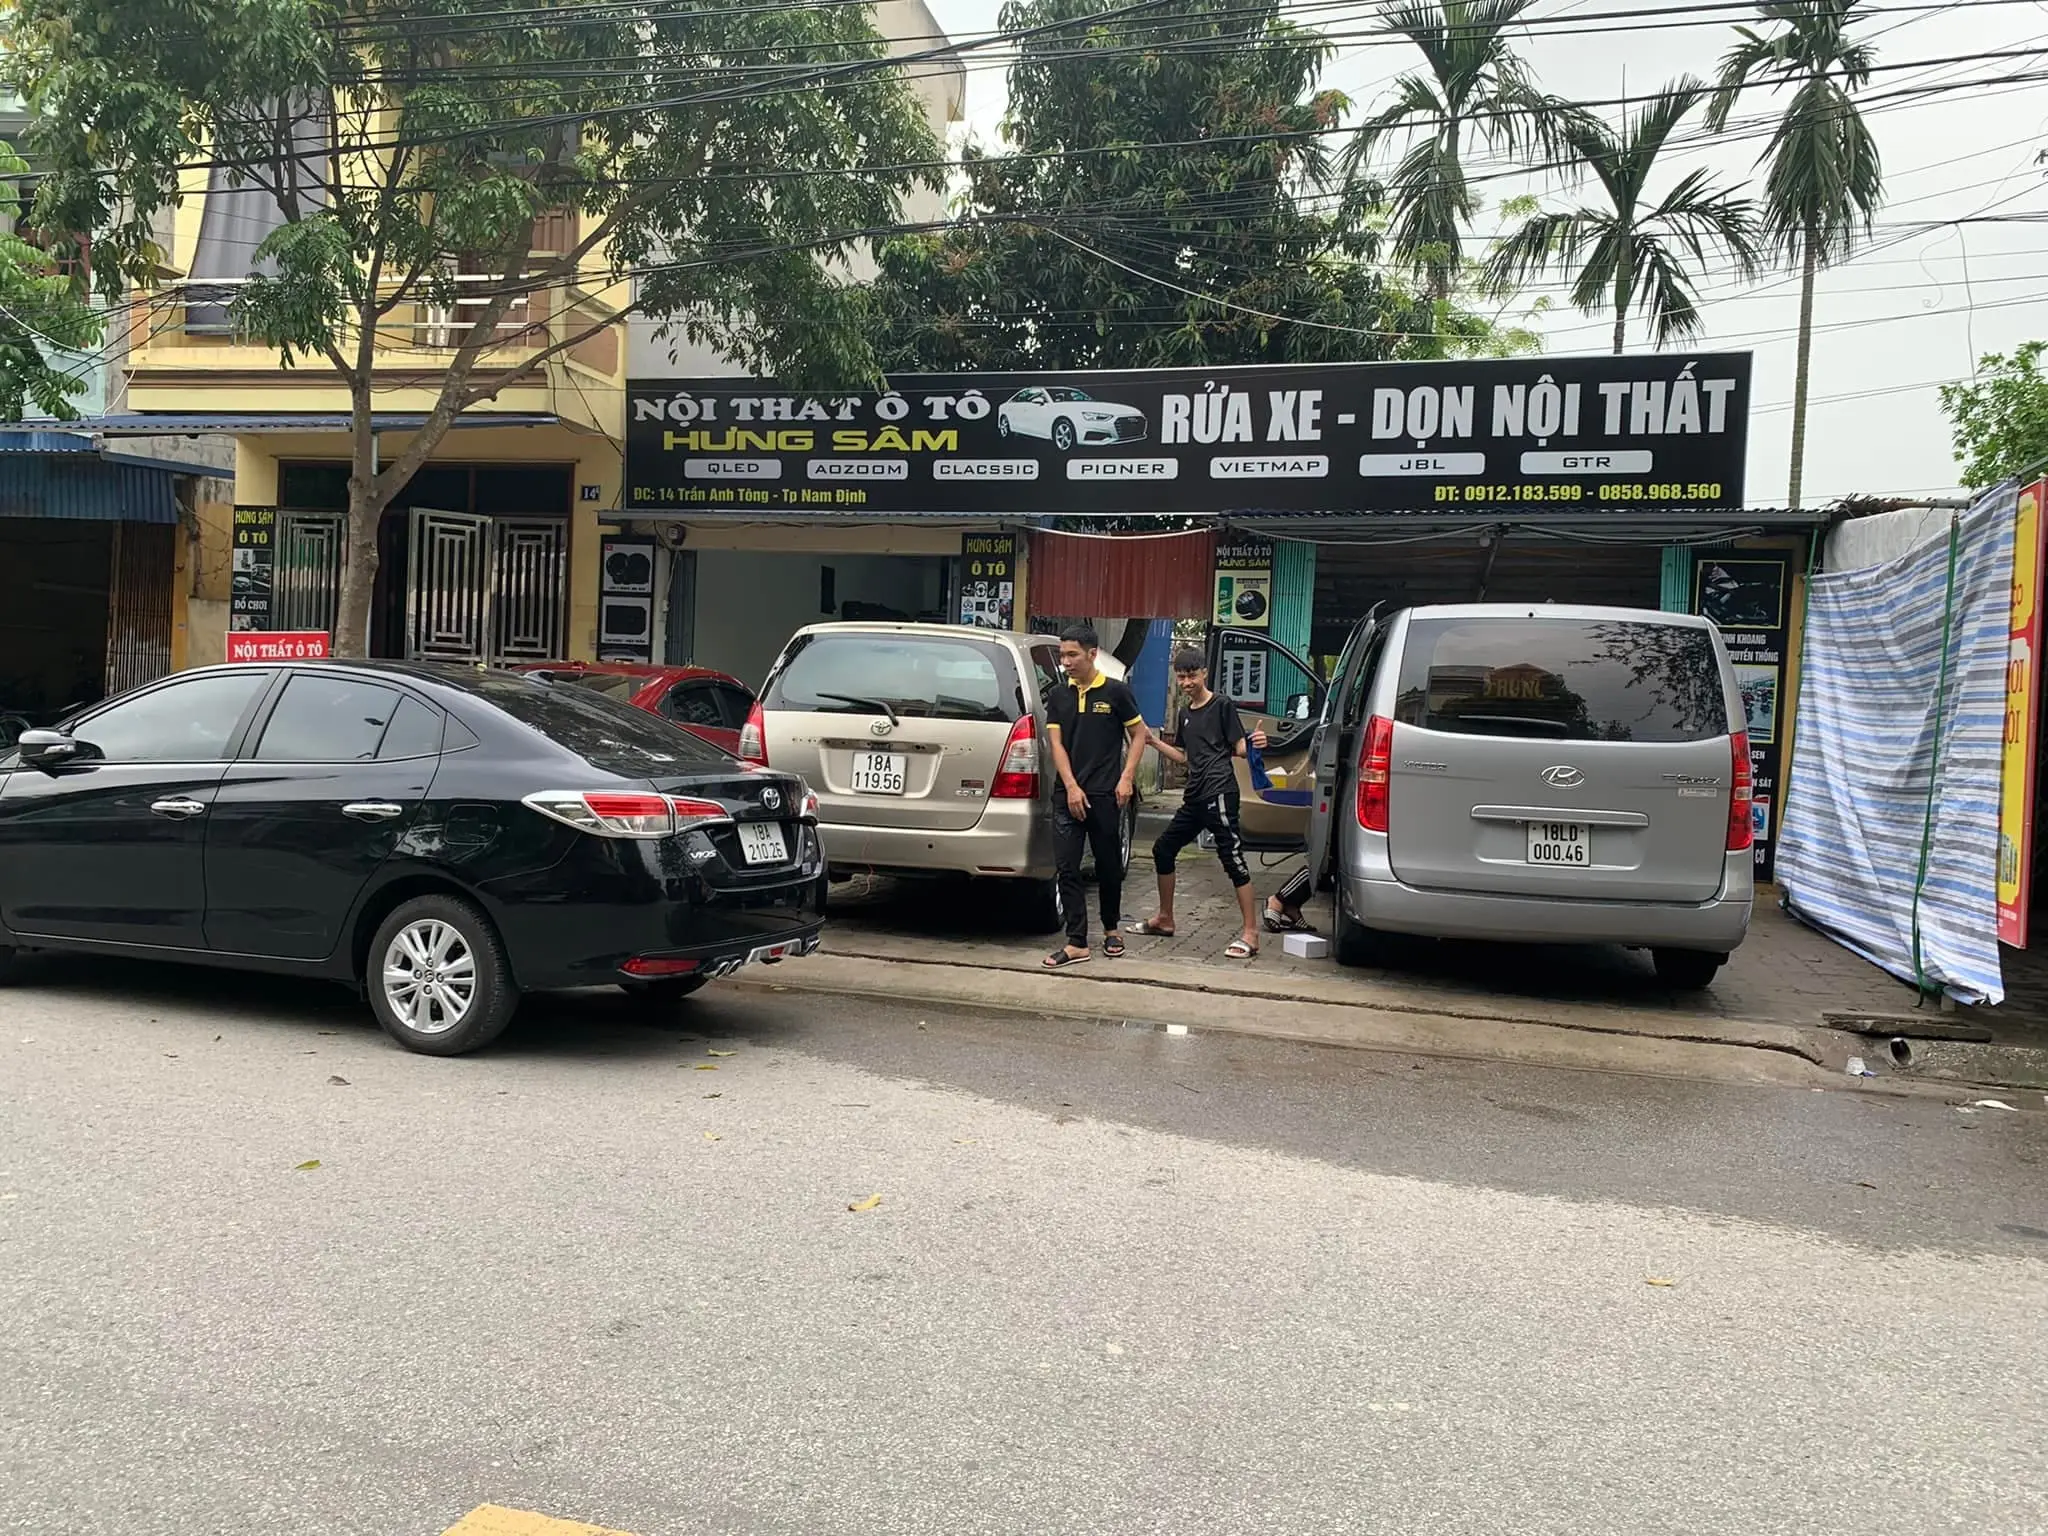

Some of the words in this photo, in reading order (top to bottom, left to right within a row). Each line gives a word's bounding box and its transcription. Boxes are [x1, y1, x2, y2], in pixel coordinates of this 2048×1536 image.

[633, 391, 717, 427] NỘI
[875, 390, 910, 421] Ô
[923, 389, 991, 421] TÔ
[1161, 380, 1253, 444] RỬA
[1266, 390, 1323, 441] XE
[1338, 414, 1355, 424] -
[1372, 385, 1475, 449] DỌN
[1491, 374, 1581, 447] NỘI
[1598, 361, 1736, 436] THẤT
[663, 426, 814, 451] HƯNG
[832, 425, 958, 451] SÂM
[708, 463, 760, 474] QLED
[815, 464, 902, 475] AOZOOM
[939, 464, 1034, 475] CLACSSIC
[1081, 463, 1166, 475] PIONER
[1219, 460, 1320, 473] VIETMAP
[1399, 458, 1446, 470] JBL
[1562, 456, 1611, 468] GTR
[659, 487, 675, 501] 14
[709, 487, 734, 502] Anh
[782, 488, 797, 504] Tp
[801, 488, 832, 503] Nam
[835, 488, 867, 505] Định
[1464, 485, 1582, 501] 0912.183.599
[1599, 483, 1721, 500] 0858.968.560
[239, 529, 248, 544] Ô
[251, 530, 268, 544] TÔ
[971, 560, 982, 576] Ô
[986, 560, 1006, 576] TÔ
[234, 641, 259, 661] NỘI
[260, 639, 294, 657] THẤT
[296, 640, 305, 657] Ô
[308, 640, 323, 656] TÔ
[866, 754, 892, 773] 18A
[855, 772, 902, 790] 119.56
[752, 823, 771, 840] 18A
[1542, 824, 1579, 842] 18LD
[748, 842, 783, 861] 210.26
[1533, 843, 1583, 862] 000.46
